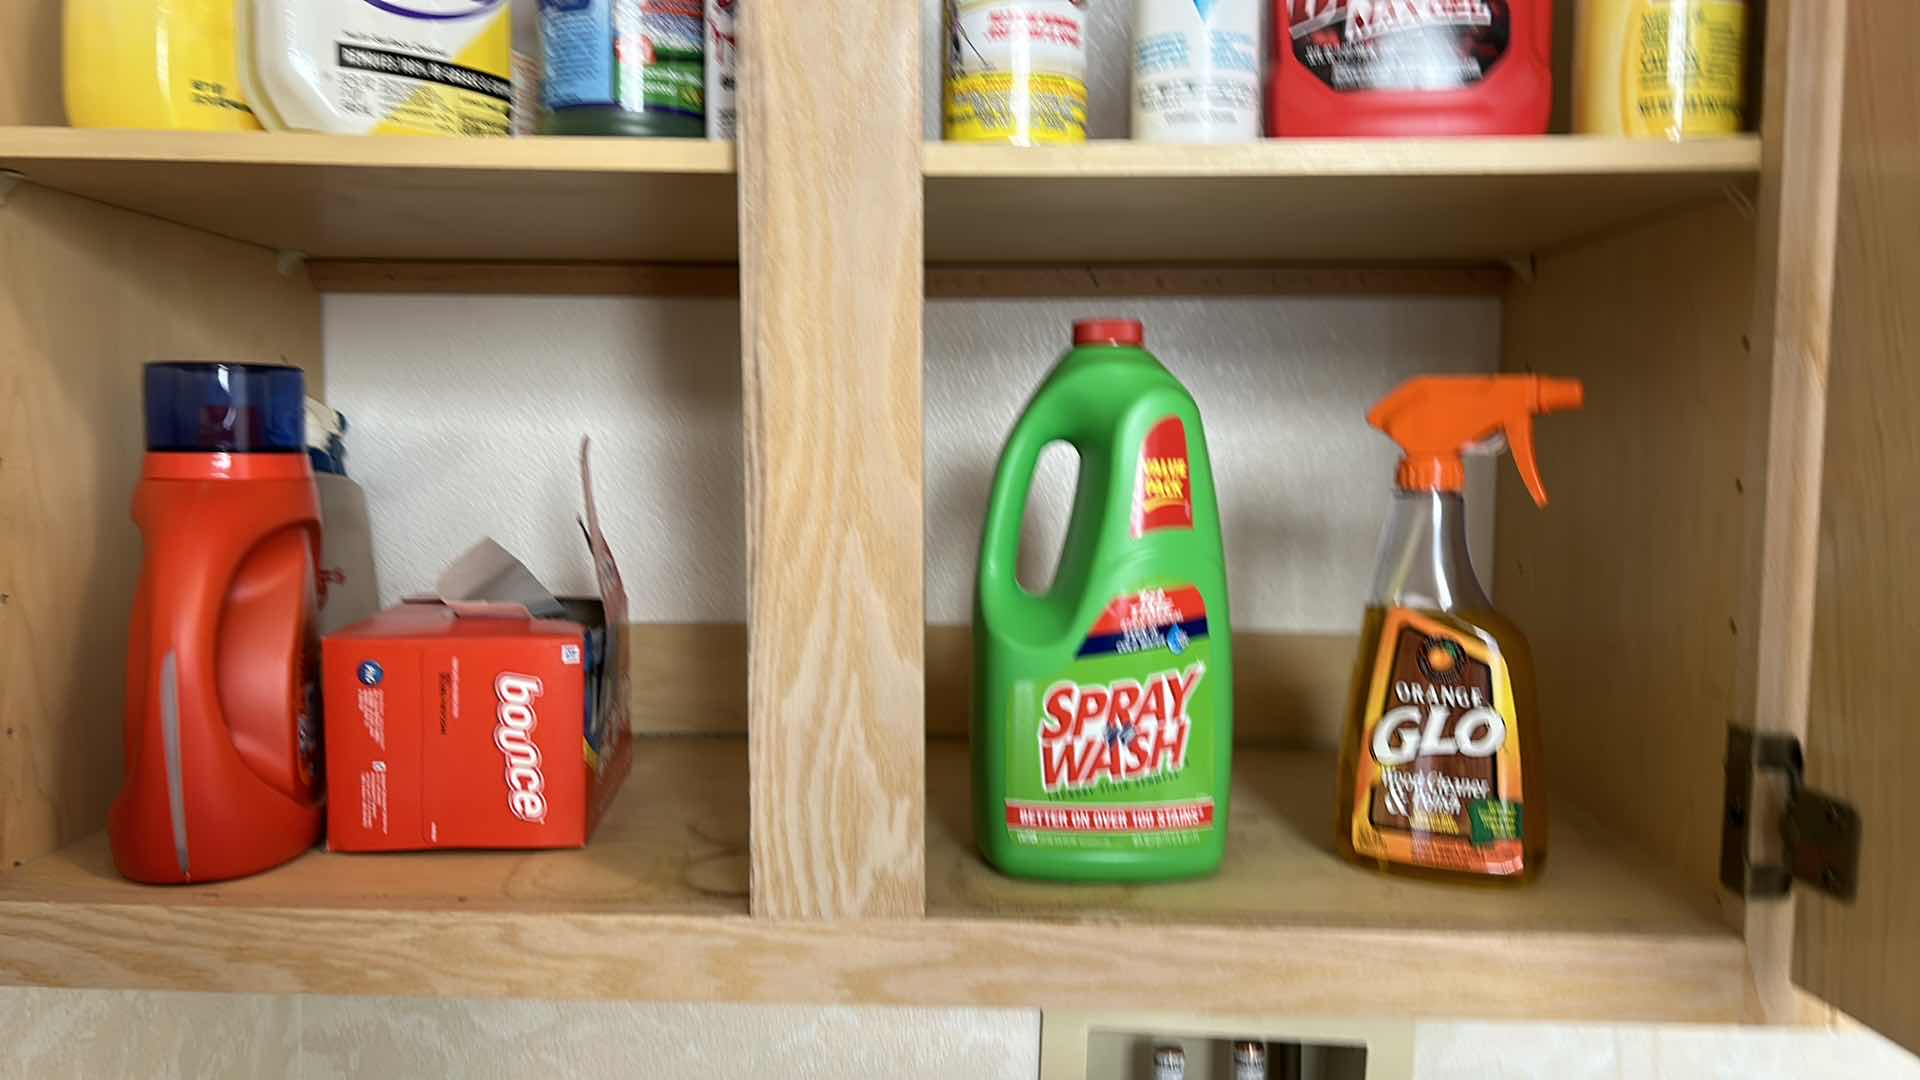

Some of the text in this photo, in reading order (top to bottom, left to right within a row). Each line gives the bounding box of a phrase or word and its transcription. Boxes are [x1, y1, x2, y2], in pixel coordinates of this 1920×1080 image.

[1041, 664, 1203, 740] SPRAY
[1396, 681, 1483, 709] ORANGE
[495, 671, 547, 824] bounce
[1040, 721, 1189, 788] WASH
[1372, 704, 1506, 767] GLO
[1019, 807, 1068, 827] BETTER
[1071, 809, 1091, 829] ON
[1093, 810, 1129, 830] OVER
[1132, 808, 1155, 829] 100
